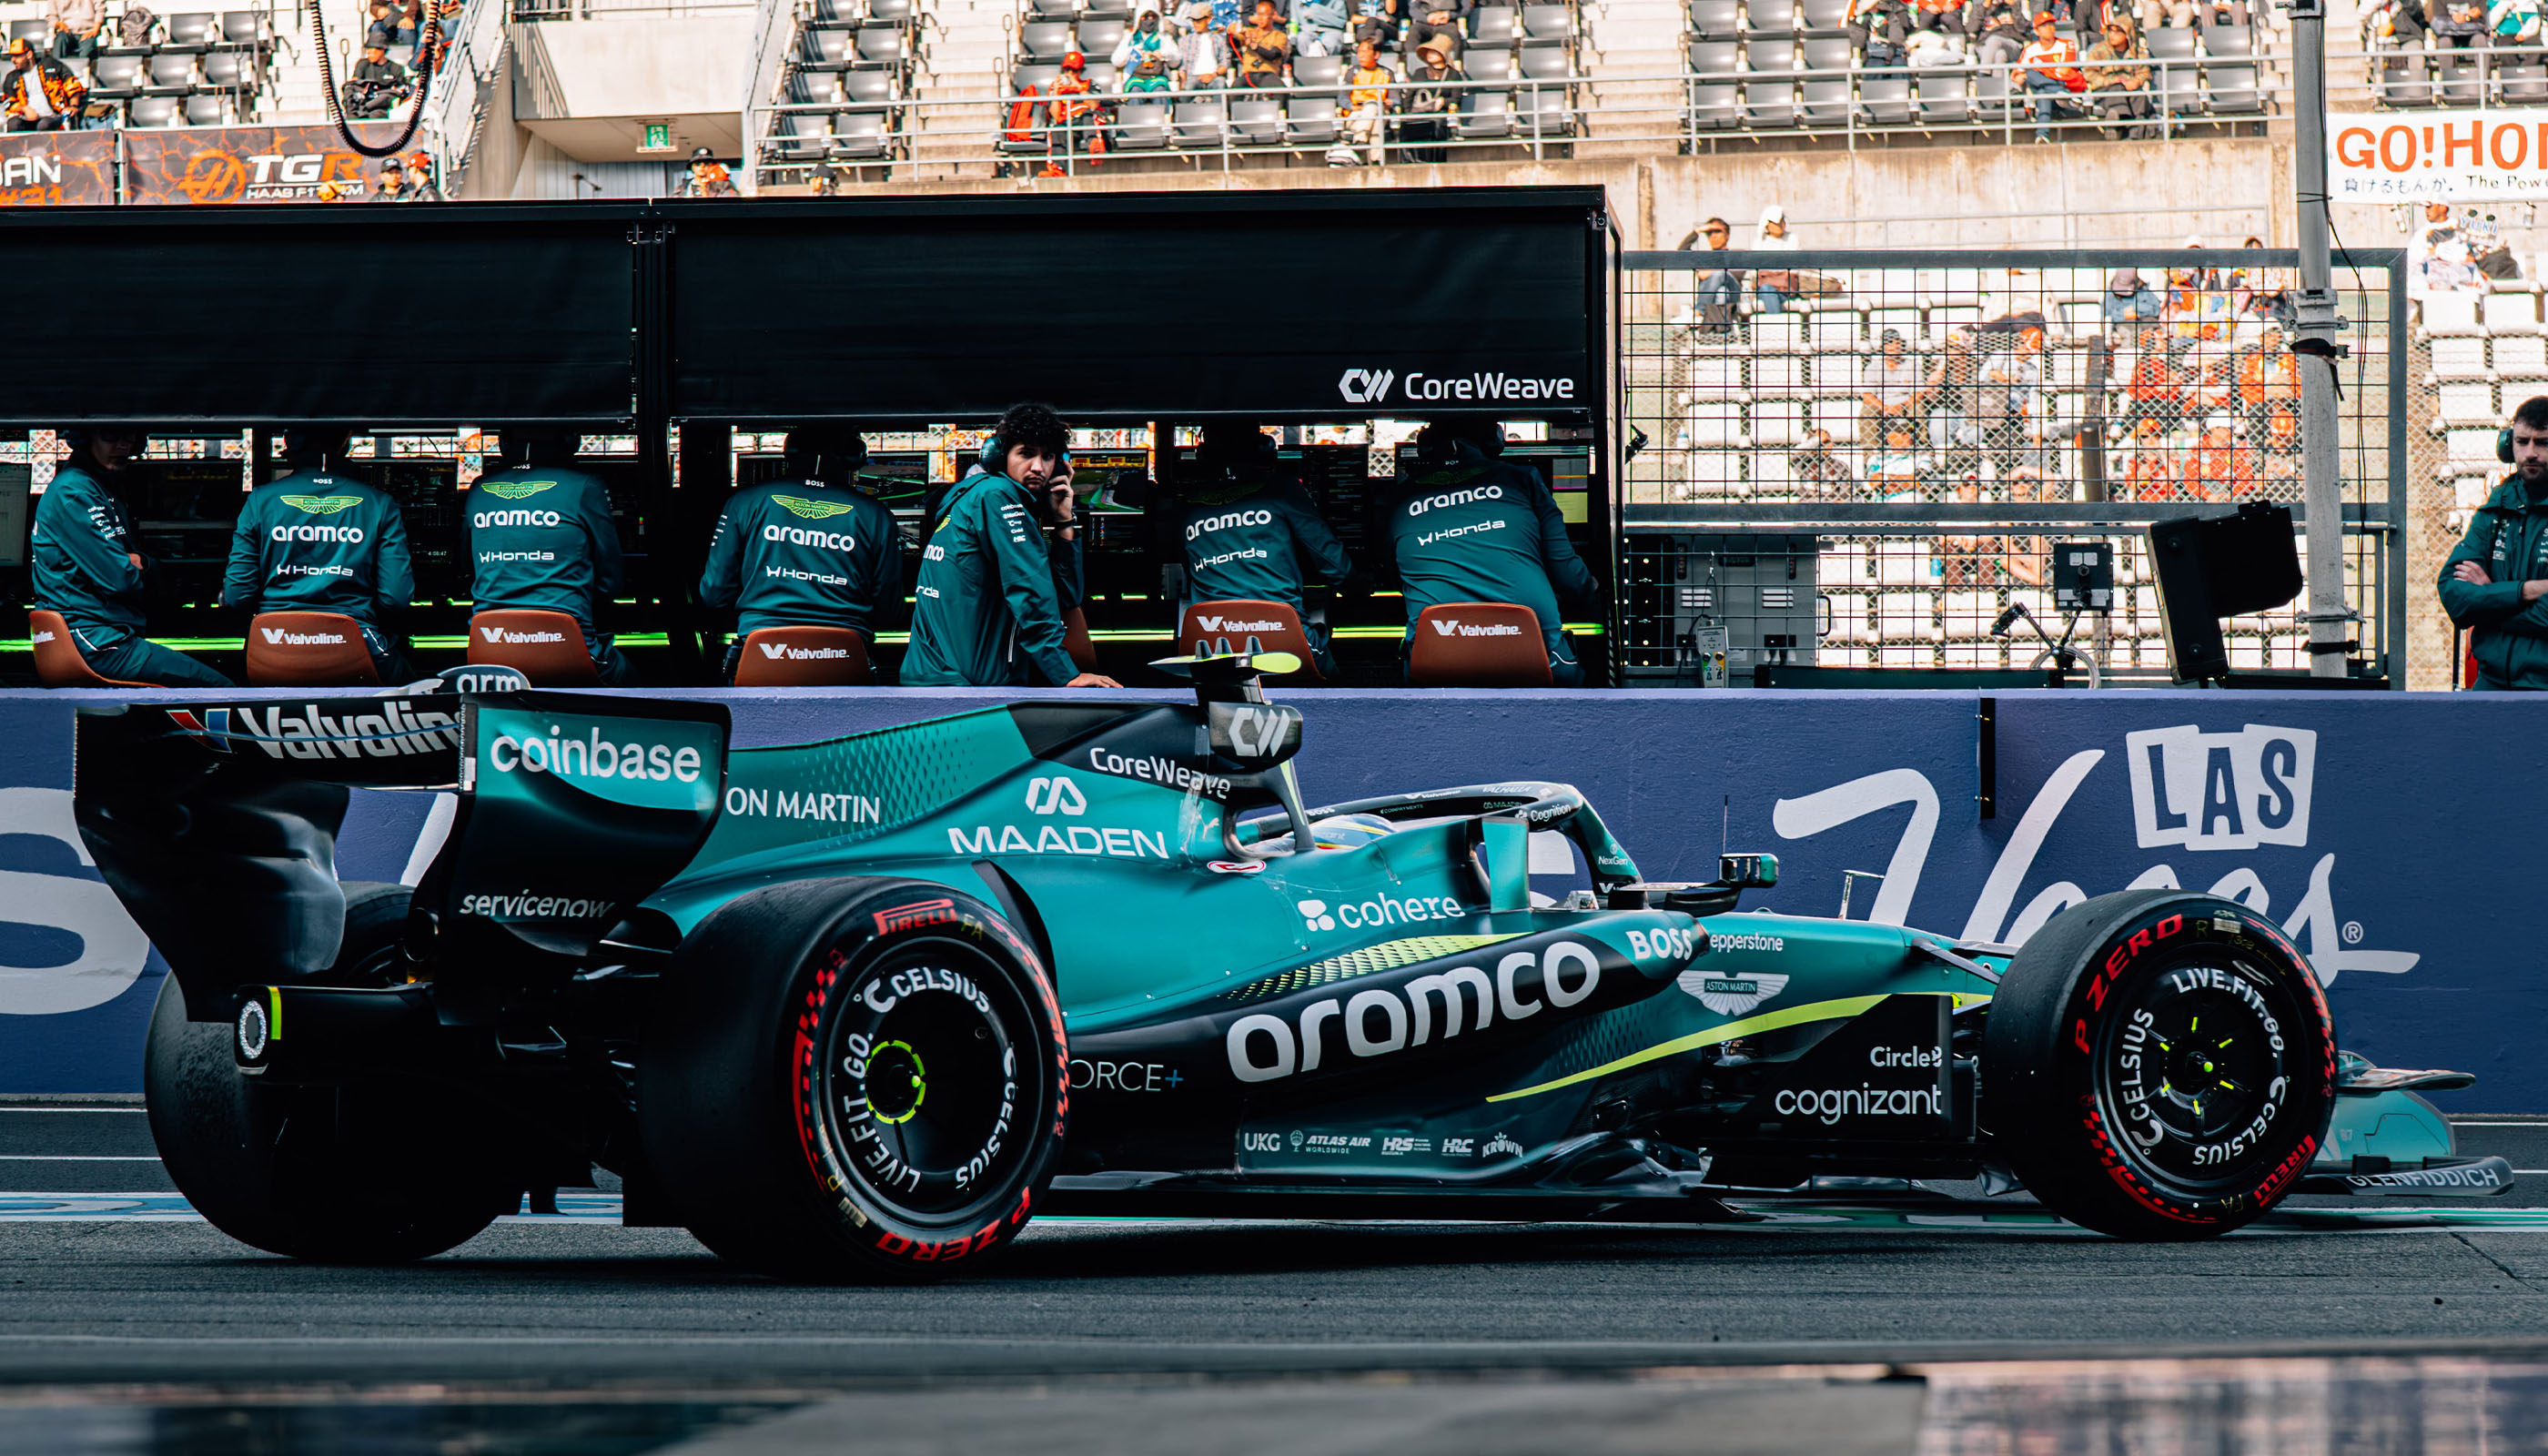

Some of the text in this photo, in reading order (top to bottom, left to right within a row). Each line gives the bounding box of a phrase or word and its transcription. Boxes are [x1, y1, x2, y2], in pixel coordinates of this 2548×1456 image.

[0, 157, 61, 187] AN
[247, 153, 363, 184] TGR
[2466, 175, 2500, 189] The
[246, 187, 294, 199] HAAS
[296, 187, 315, 198] F1
[1405, 372, 1573, 399] CoreWeave
[1409, 485, 1502, 516] aramco
[474, 510, 561, 528] aramco
[1186, 510, 1271, 541] aramco
[1435, 520, 1505, 541] Honda
[272, 526, 363, 543] aramco
[763, 525, 855, 552] aramco
[293, 565, 353, 576] Honda
[491, 551, 554, 561] Honda
[1203, 548, 1267, 566] Honda
[783, 568, 847, 585] Honda
[238, 701, 460, 758] Valvolin
[490, 726, 702, 782] coinbase
[1090, 747, 1230, 800] CoreWeave
[2148, 740, 2297, 836] LAS
[776, 789, 879, 823] MARTIN
[1530, 804, 1572, 823] Cognition
[947, 825, 1169, 858] MAADEN
[1598, 855, 1629, 865] NexGen
[459, 889, 616, 918] servicenow
[873, 898, 957, 936] PIRELLI
[1338, 893, 1465, 930] cohere
[1626, 927, 1692, 960] BOSS
[2086, 914, 2182, 1012] ZERO
[891, 967, 989, 1014] CELSIUS
[1705, 980, 1757, 993] ASTON MARTIN
[1227, 940, 1601, 1083] aramco
[2120, 1007, 2154, 1121] CELSIUS
[1775, 1082, 1942, 1125] cognizant
[956, 1080, 1018, 1190] CELSIUS
[1244, 1132, 1280, 1152] UKG
[1307, 1136, 1370, 1147] ATLAS AIR
[1382, 1137, 1414, 1151] HRS
[1441, 1138, 1474, 1153] HRC
[1482, 1138, 1523, 1158] KROWN
[2192, 1102, 2276, 1166] CELSIUS
[2253, 1135, 2316, 1208] PIRELLI
[2345, 1168, 2501, 1187] GLENFIDDICH
[875, 1219, 999, 1262] ZERO
